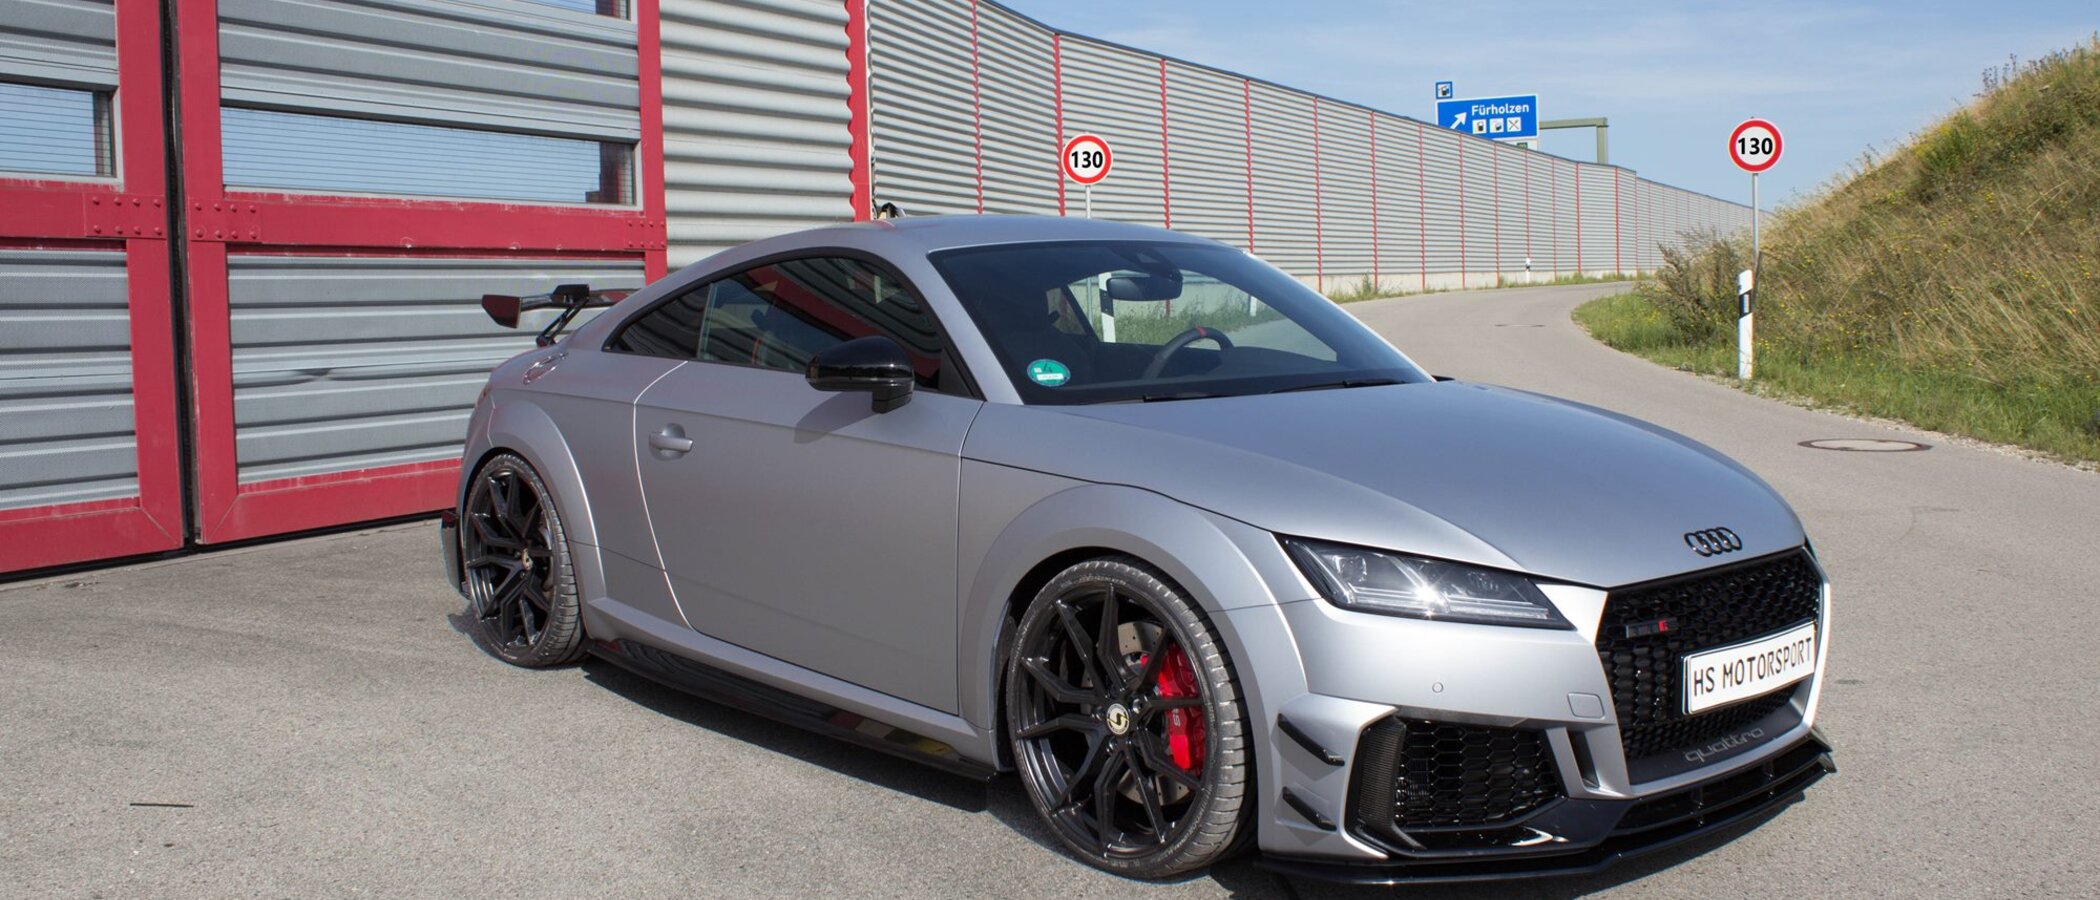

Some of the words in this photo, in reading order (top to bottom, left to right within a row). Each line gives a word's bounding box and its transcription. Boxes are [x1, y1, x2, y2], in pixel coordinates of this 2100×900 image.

[1471, 103, 1530, 116] Fürholzen
[1738, 137, 1773, 155] 130
[1071, 150, 1103, 169] 130
[1693, 666, 1715, 697] HS
[1722, 637, 1812, 689] MOTORSPORT
[1684, 727, 1766, 762] quattro
